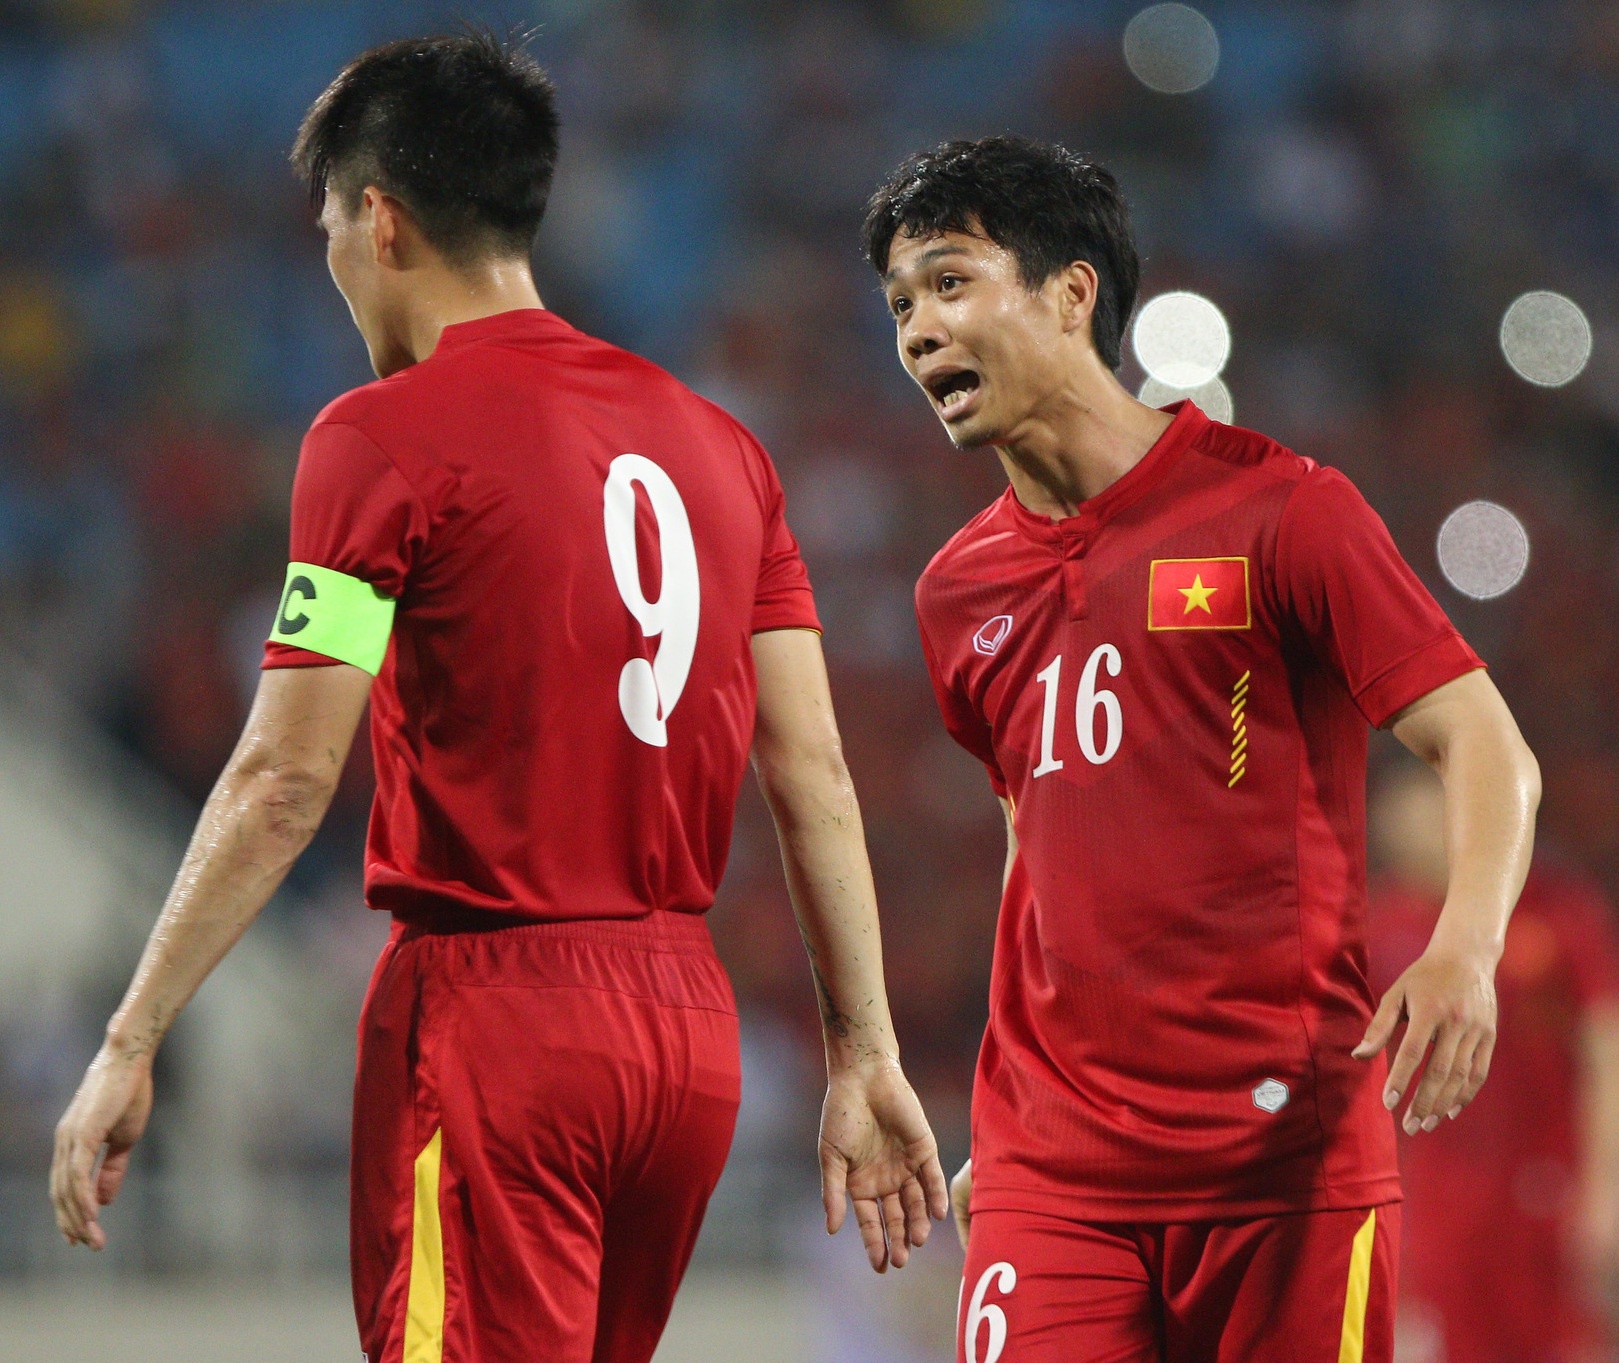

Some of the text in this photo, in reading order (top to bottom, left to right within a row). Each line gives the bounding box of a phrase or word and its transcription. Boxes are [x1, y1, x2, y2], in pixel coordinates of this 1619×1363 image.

[278, 575, 317, 635] C
[603, 453, 700, 748] 9
[1033, 643, 1123, 779] 16
[956, 1261, 1017, 1363] 6
